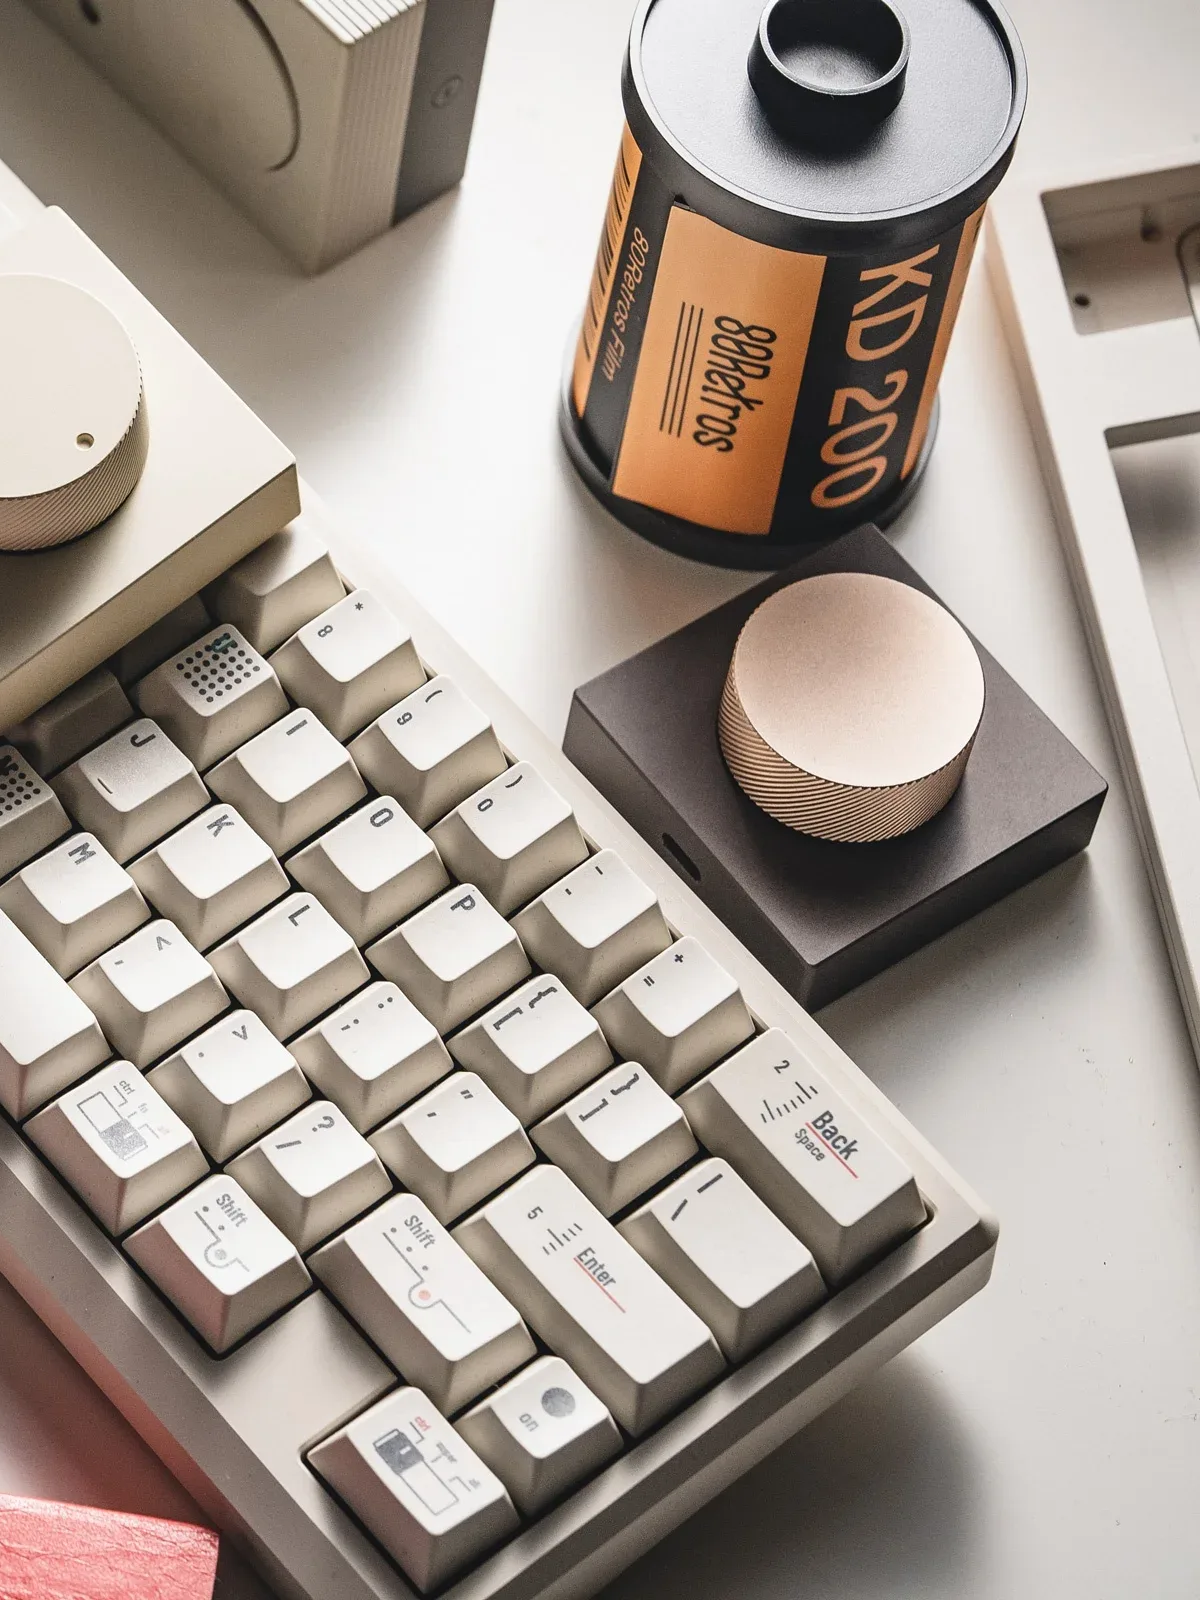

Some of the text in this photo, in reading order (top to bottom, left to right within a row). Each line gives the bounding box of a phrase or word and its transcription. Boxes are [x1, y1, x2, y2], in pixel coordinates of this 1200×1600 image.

[601, 227, 650, 382] 80Retros Film
[692, 315, 778, 453] 80Retros
[810, 244, 940, 509] KD 200
[317, 625, 334, 638] 8
[286, 719, 308, 736] I
[396, 712, 413, 726] 9
[130, 733, 157, 748] J
[206, 814, 235, 838] K
[67, 842, 97, 866] M
[450, 894, 476, 911] P
[288, 904, 311, 927] L
[674, 953, 684, 964] +
[492, 1007, 523, 1031] [
[773, 1059, 791, 1075] 2
[118, 1080, 136, 1097] ctrl
[578, 1098, 609, 1122] ]
[311, 1115, 336, 1133] ?
[811, 1110, 859, 1161] Back
[794, 1128, 827, 1163] Space
[215, 1192, 249, 1228] Shift
[527, 1206, 544, 1220] 5
[403, 1213, 436, 1250] Shift
[576, 1247, 616, 1289] Enter
